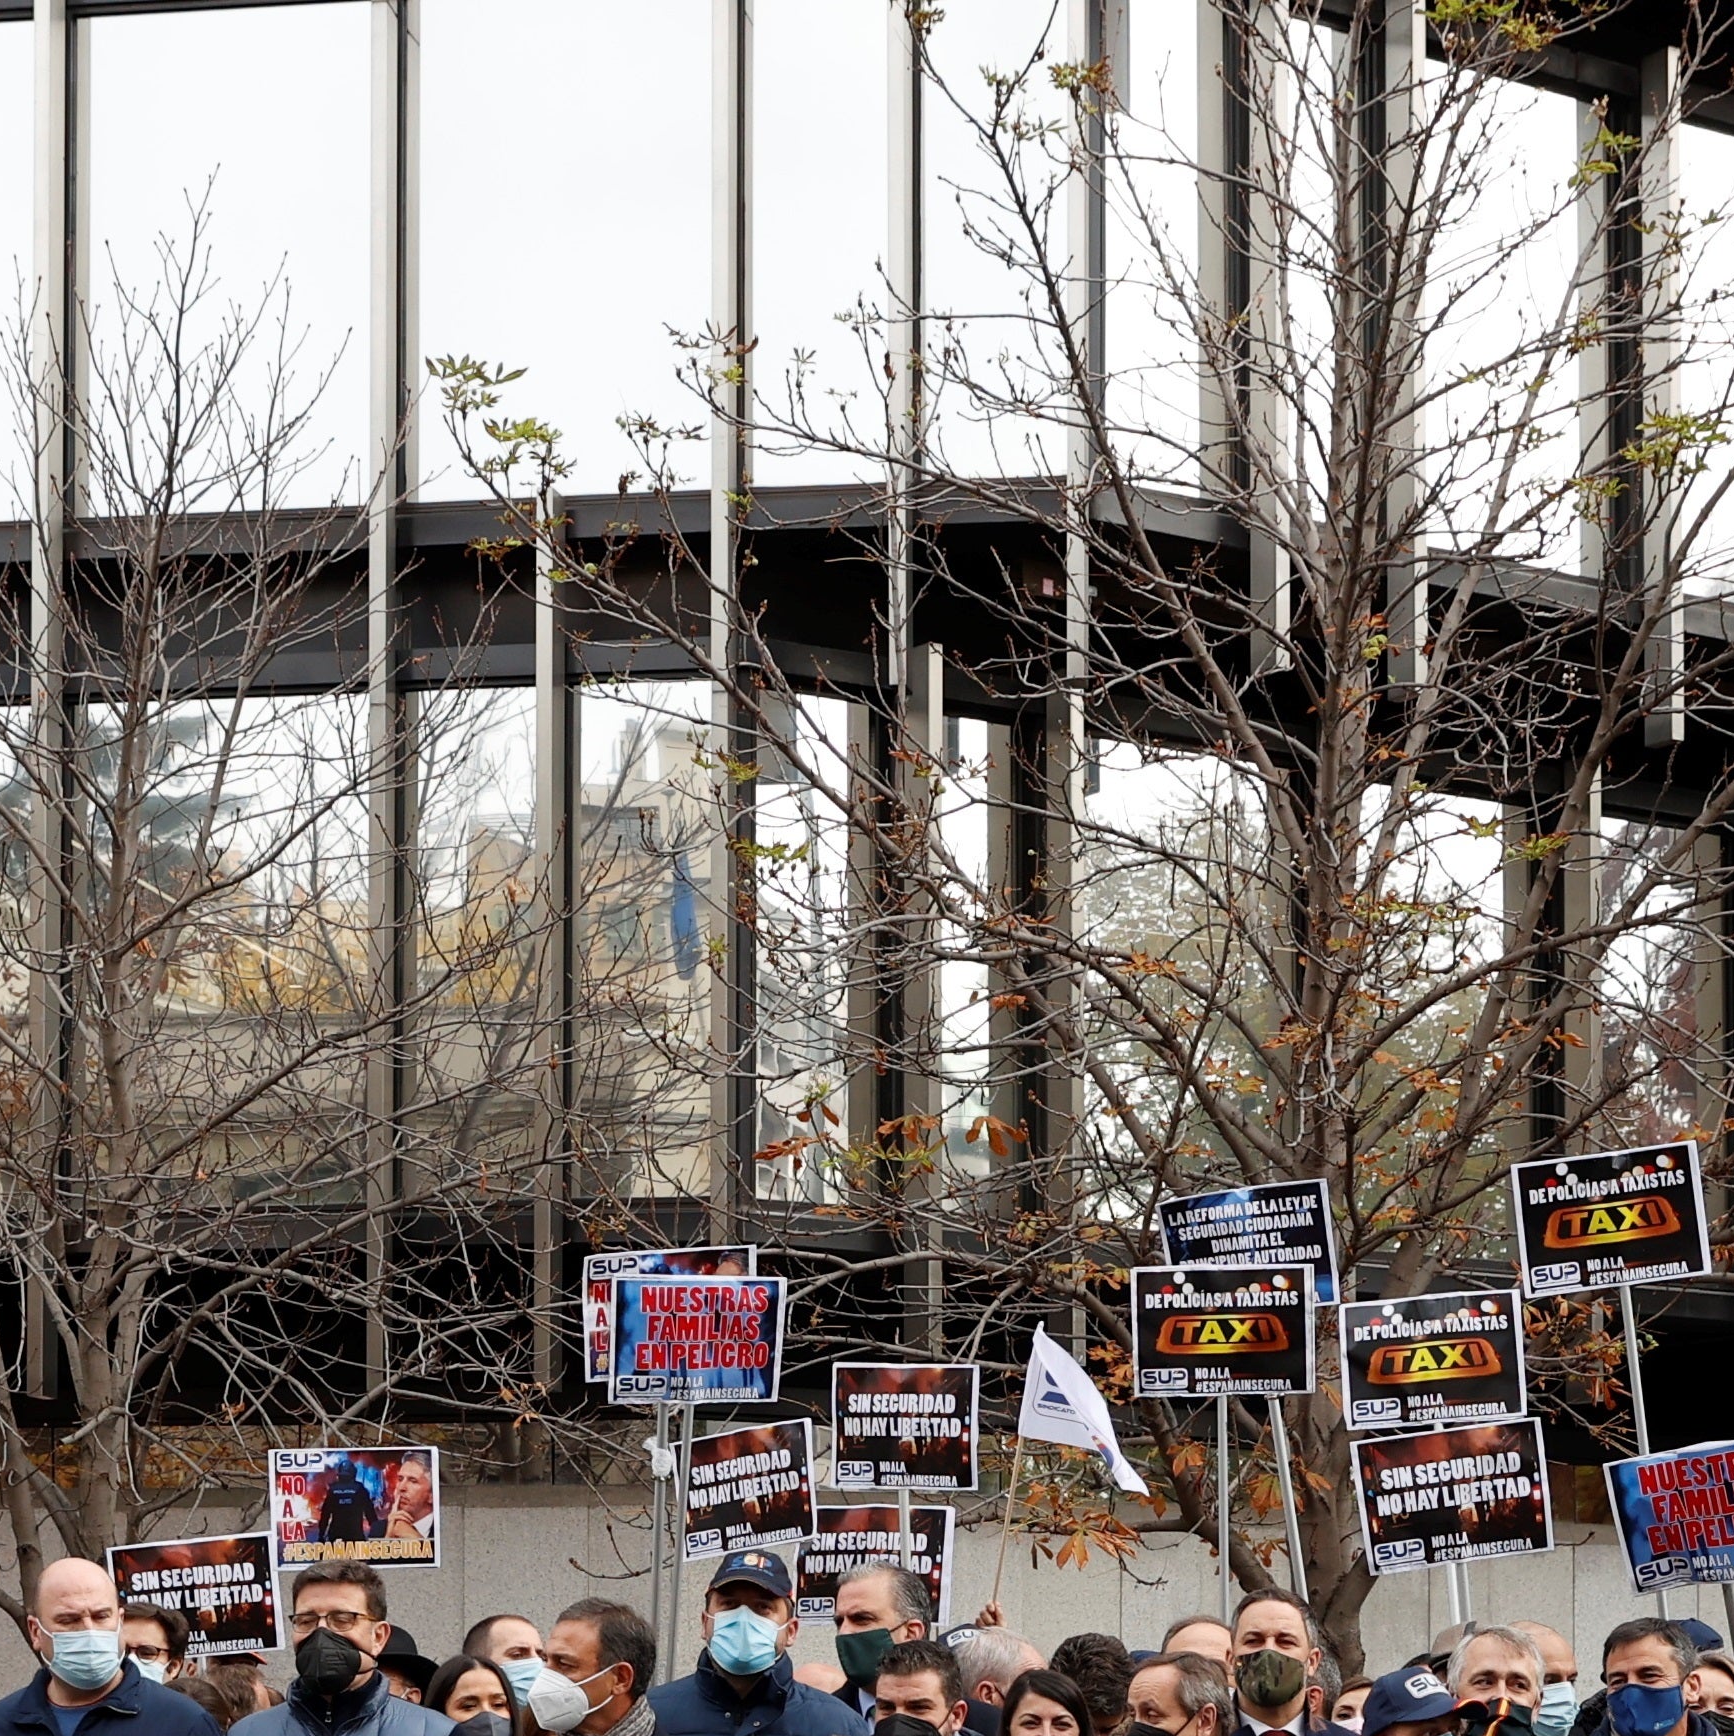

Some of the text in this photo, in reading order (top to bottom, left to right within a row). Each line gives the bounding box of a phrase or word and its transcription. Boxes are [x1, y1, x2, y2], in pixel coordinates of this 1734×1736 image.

[1529, 1188, 1546, 1205] DE
[1620, 1169, 1685, 1193] TAXISTAS
[1169, 1195, 1317, 1226] LA REFORMA DE LA LEY DE
[1563, 1203, 1660, 1237] TAXI
[1179, 1212, 1313, 1241] SEGURIDAD CIUDADANA
[1211, 1232, 1285, 1253] DINAMITA EL
[1254, 1245, 1322, 1264] AUTORIDAD
[592, 1258, 638, 1275] SUP
[1534, 1265, 1578, 1282] SUP
[641, 1286, 769, 1313] NUESTRAS
[1145, 1294, 1161, 1309] DE
[1163, 1290, 1223, 1308] POLICÍAS
[1235, 1291, 1298, 1306] TAXISTAS
[648, 1314, 760, 1342] FAMILIAS
[1176, 1320, 1271, 1343] TAXI
[1354, 1327, 1371, 1341] DE
[1444, 1315, 1508, 1332] TAXISTAS
[635, 1343, 666, 1370] EN
[670, 1343, 769, 1370] PELIGRO
[1386, 1342, 1484, 1373] TAXI
[619, 1378, 665, 1392] SUP
[1144, 1371, 1186, 1384] SUP
[848, 1394, 956, 1413] SIN SEGURIDAD
[1356, 1402, 1398, 1415] SUP
[844, 1417, 961, 1437] NO HAY LIBERTAD
[280, 1454, 322, 1467] SUP
[691, 1449, 791, 1485] SIN SEGURIDAD
[840, 1464, 872, 1476] SUP
[1381, 1452, 1521, 1490] SIN SEGURIDAD
[281, 1476, 306, 1496] NO
[689, 1471, 799, 1509] NO HAY LIBERTAD
[1376, 1477, 1530, 1516] NO HAY LIBERTAD
[283, 1499, 293, 1517] A
[281, 1521, 306, 1541] LA
[688, 1531, 719, 1548] SUP
[812, 1532, 836, 1551] SIN
[1646, 1522, 1685, 1555] EN
[283, 1538, 433, 1561] #ESPAÑAINSEGURA
[1377, 1541, 1422, 1560] SUP
[805, 1555, 824, 1574] NO
[1639, 1558, 1687, 1582] SUP
[131, 1562, 255, 1591] SIN SEGURIDAD
[185, 1584, 263, 1608] LIBERTAD
[800, 1600, 833, 1612] SUP
